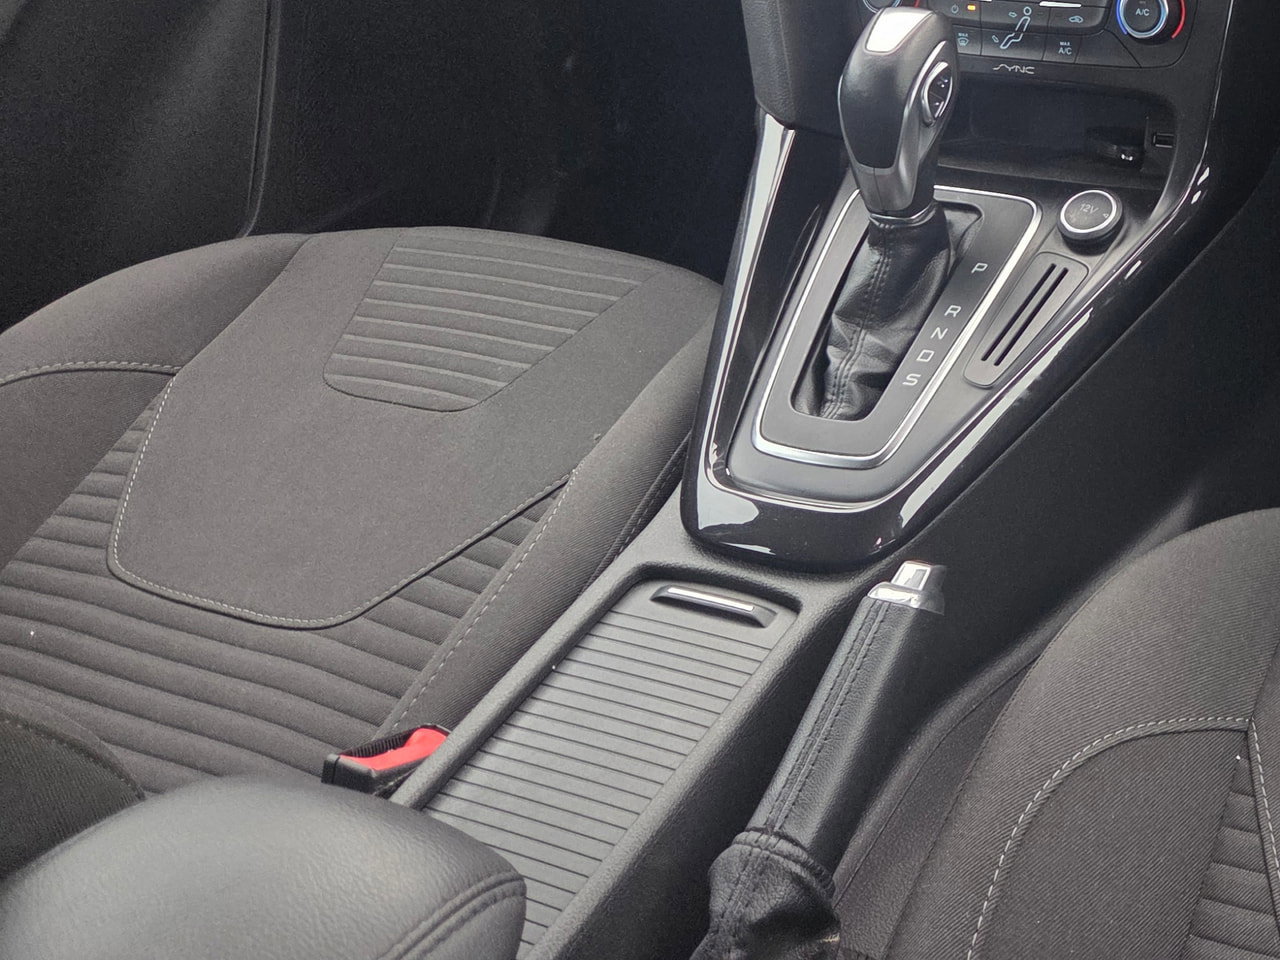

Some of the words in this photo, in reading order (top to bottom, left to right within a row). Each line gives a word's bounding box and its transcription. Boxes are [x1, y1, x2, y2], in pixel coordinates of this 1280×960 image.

[1135, 7, 1151, 17] A/C
[1058, 46, 1073, 56] A/C
[993, 63, 1036, 75] SYNC
[1079, 202, 1098, 214] 12V
[971, 262, 988, 274] P
[944, 305, 962, 318] R
[930, 327, 948, 340] N
[916, 349, 935, 363] D
[902, 373, 922, 386] S
